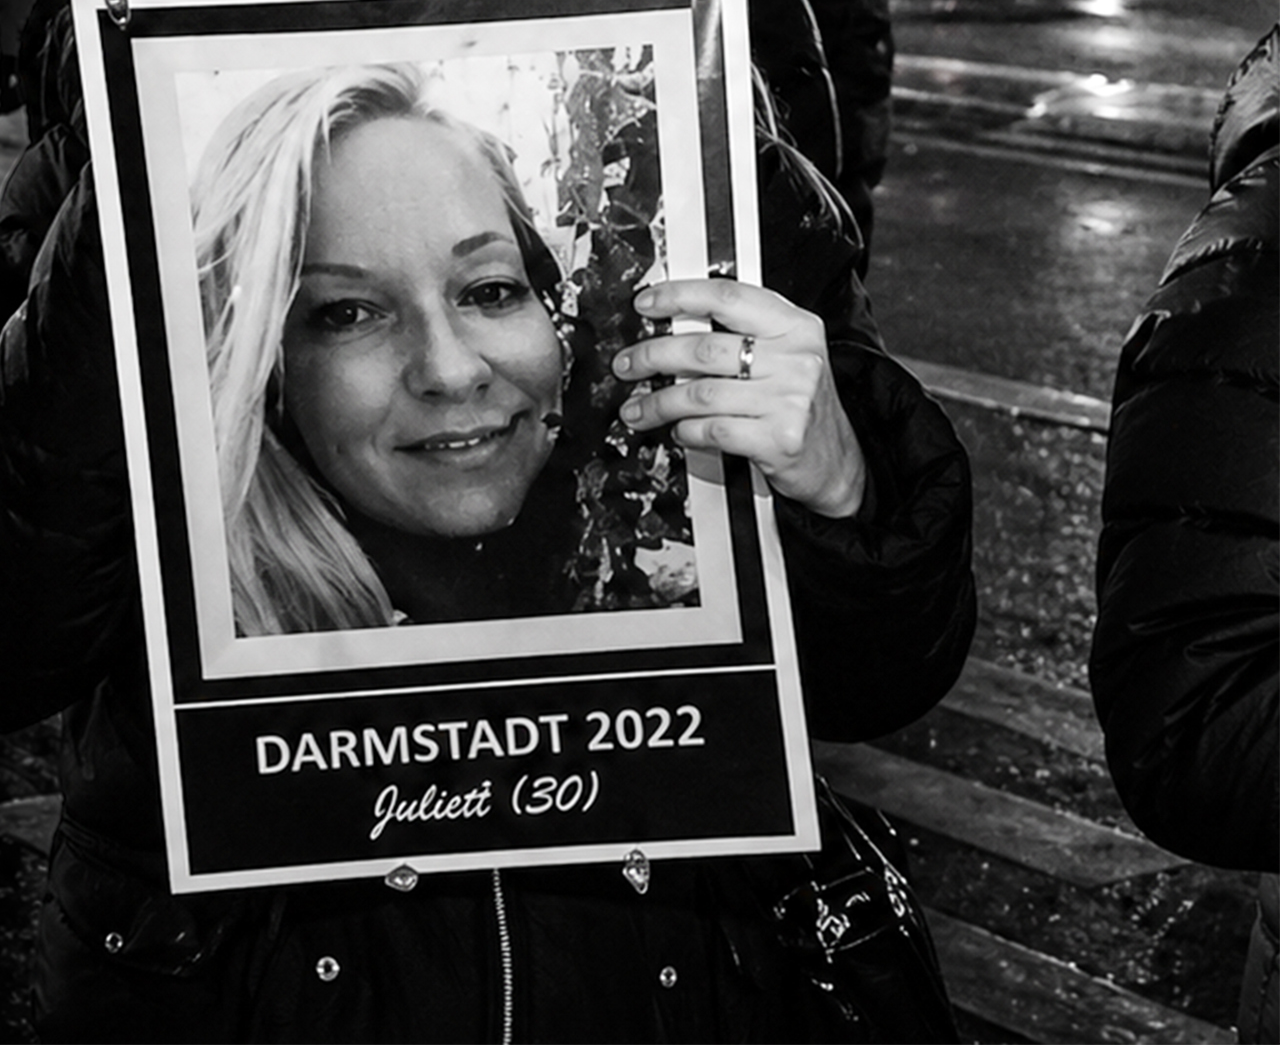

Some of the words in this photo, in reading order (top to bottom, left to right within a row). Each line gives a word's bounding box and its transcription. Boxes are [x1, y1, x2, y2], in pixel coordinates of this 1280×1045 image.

[255, 713, 569, 775] DARMSTADT
[585, 705, 705, 751] 2022
[511, 770, 599, 815] (30)
